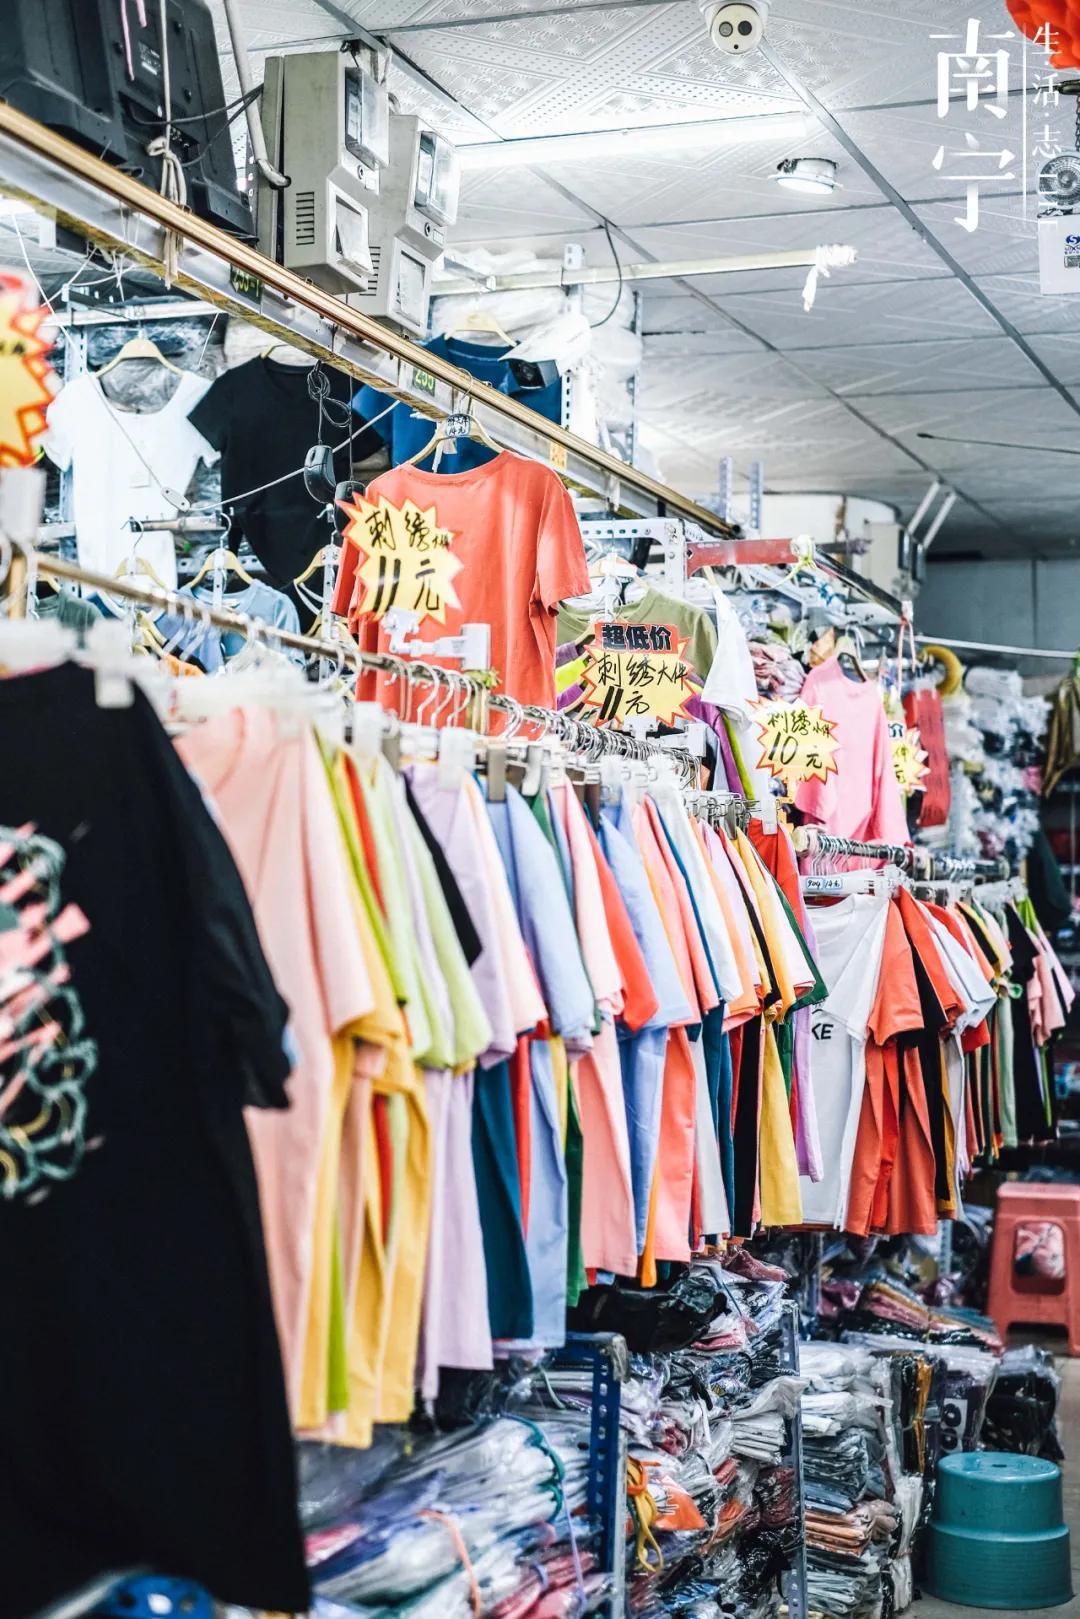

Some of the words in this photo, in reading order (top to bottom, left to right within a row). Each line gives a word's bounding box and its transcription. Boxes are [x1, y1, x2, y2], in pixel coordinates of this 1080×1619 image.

[602, 624, 672, 651] 超低价
[597, 652, 688, 690] 刺绣大件
[599, 685, 650, 720] 11元
[768, 732, 823, 770] 10元
